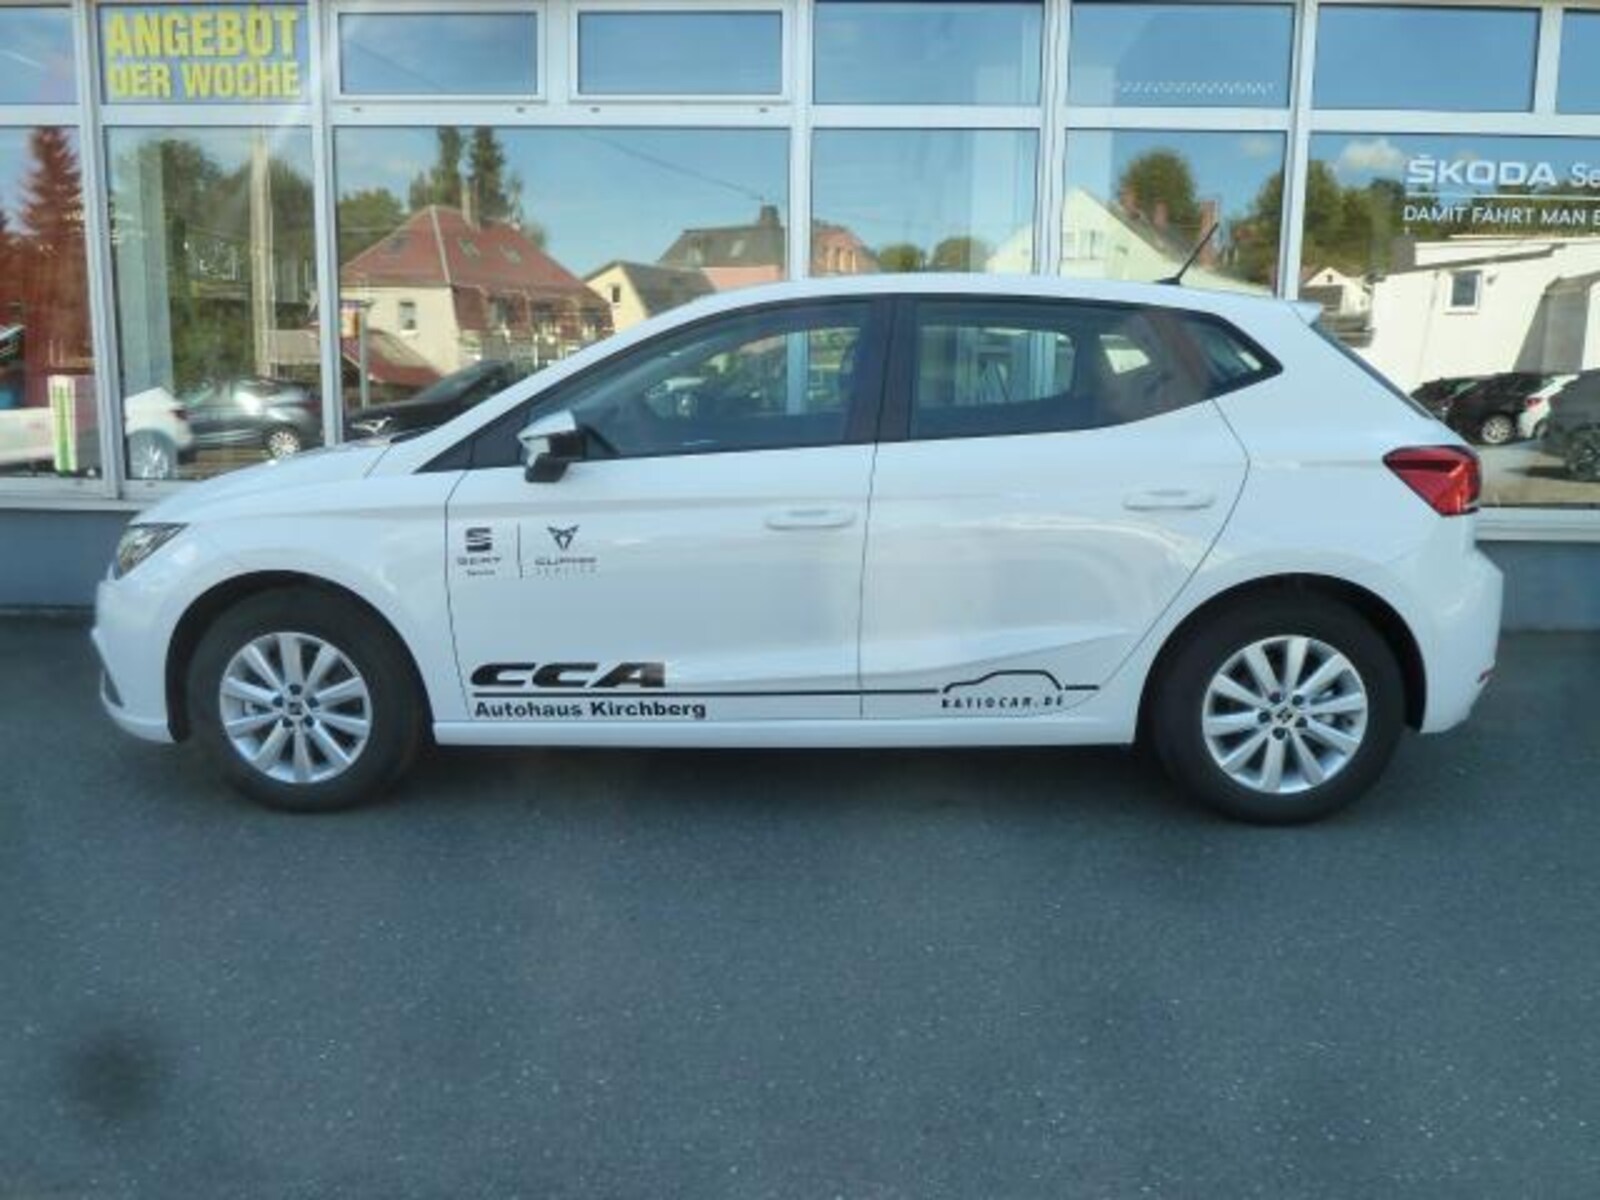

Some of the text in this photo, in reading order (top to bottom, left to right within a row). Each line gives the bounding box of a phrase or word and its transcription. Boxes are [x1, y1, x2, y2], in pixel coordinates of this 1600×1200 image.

[105, 7, 298, 58] ANGEBOT
[108, 62, 300, 98] DER WOCHE
[1406, 155, 1557, 187] ŠKODA
[1403, 206, 1466, 223] DAMIT
[1540, 208, 1586, 225] MAN
[470, 662, 666, 688] CCA
[475, 701, 707, 719] Autohaus Kirchberg
